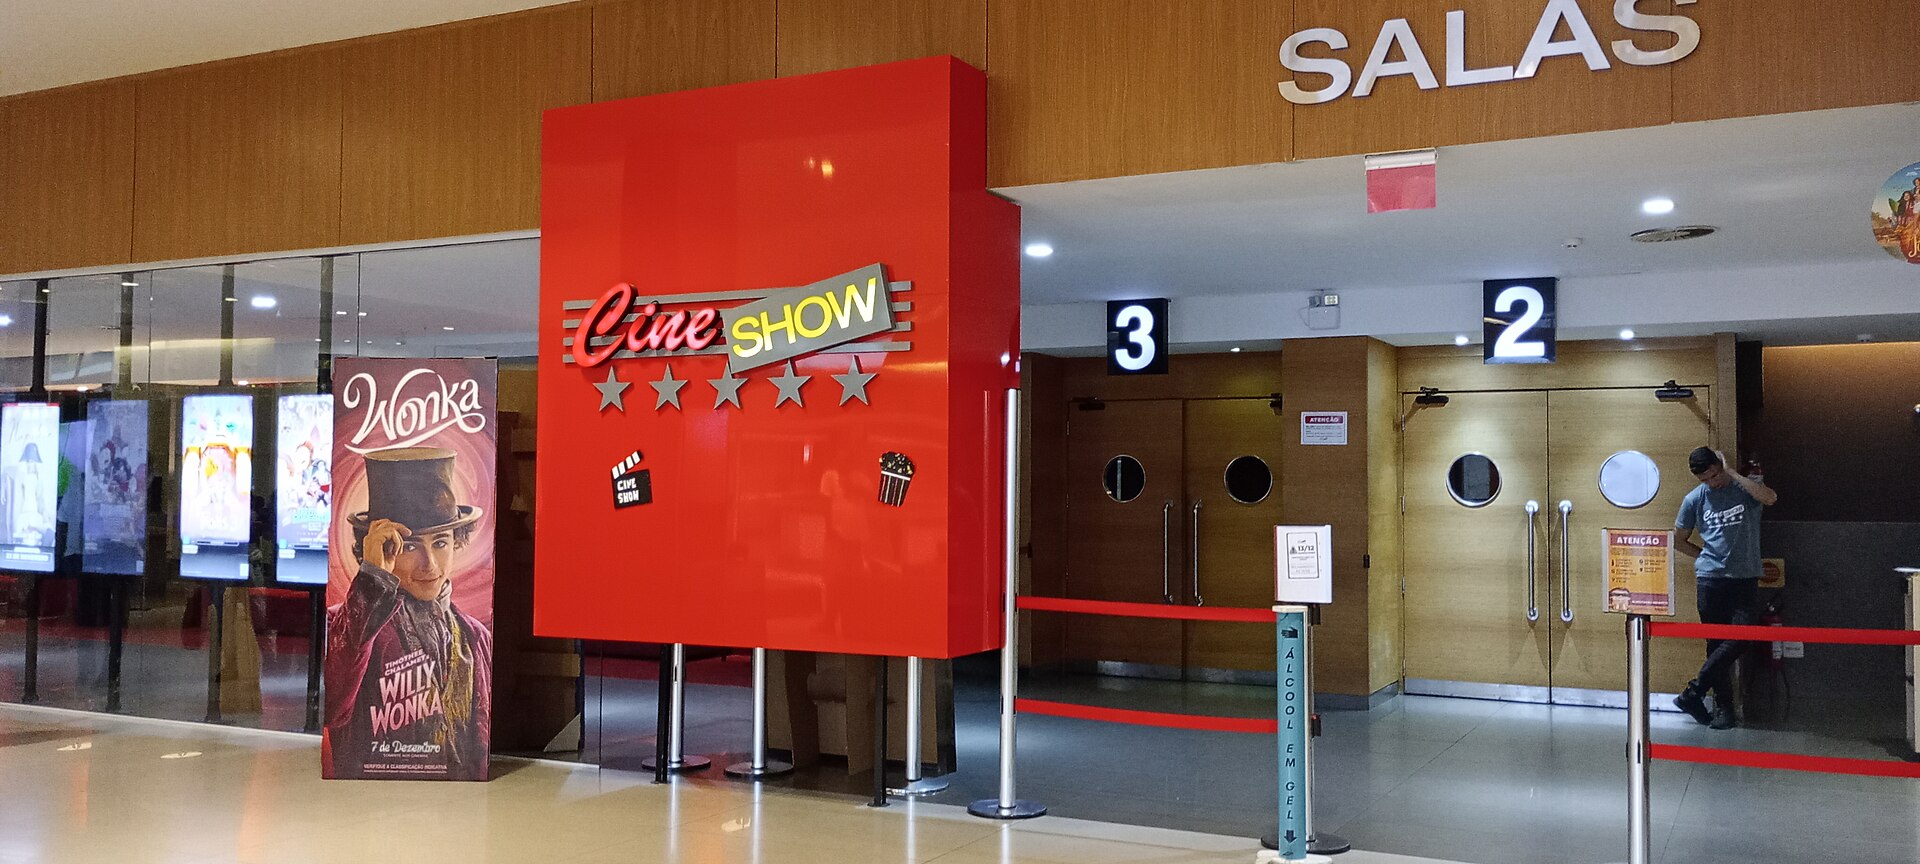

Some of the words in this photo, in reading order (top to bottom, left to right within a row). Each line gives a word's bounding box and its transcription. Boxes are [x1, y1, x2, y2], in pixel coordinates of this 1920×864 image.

[1278, 0, 1701, 104] SALAS
[573, 282, 721, 368] Cine
[731, 277, 877, 358] SHOW
[1115, 305, 1155, 370] 3
[1494, 286, 1546, 357] 2
[343, 368, 486, 454] Wonka
[617, 478, 637, 491] CINE
[617, 490, 640, 504] SHOW
[1617, 536, 1660, 546] ATENÇÃO
[379, 660, 437, 706] WILLY
[384, 654, 426, 676] CHALAMET
[1285, 647, 1295, 730] ÁLCOOL
[370, 688, 443, 737] WONKA
[371, 741, 379, 753] 7
[379, 741, 390, 753] de
[392, 740, 441, 753] Dezembro
[1285, 743, 1296, 768] EM
[1285, 782, 1295, 820] GEL
